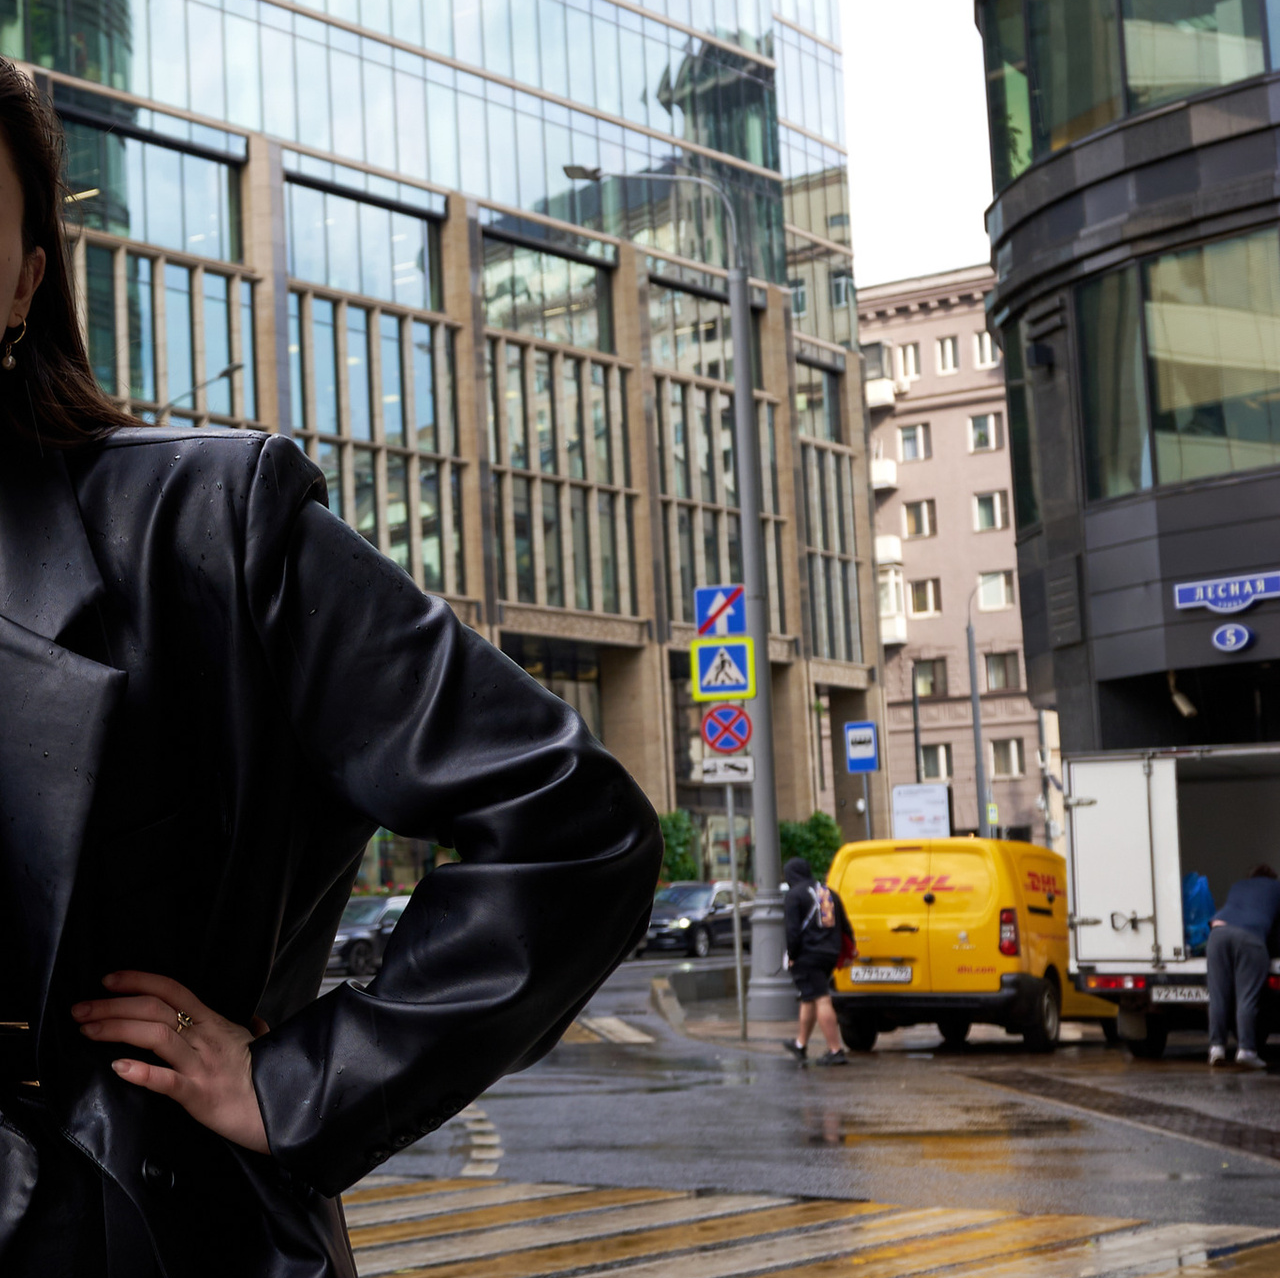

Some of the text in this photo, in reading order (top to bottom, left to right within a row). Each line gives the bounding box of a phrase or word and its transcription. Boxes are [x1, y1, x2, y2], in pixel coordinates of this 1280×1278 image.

[1195, 579, 1265, 601] ЛЕСНАЯ
[1226, 629, 1236, 646] 5
[872, 875, 956, 894] DHL
[1027, 871, 1062, 897] DHL
